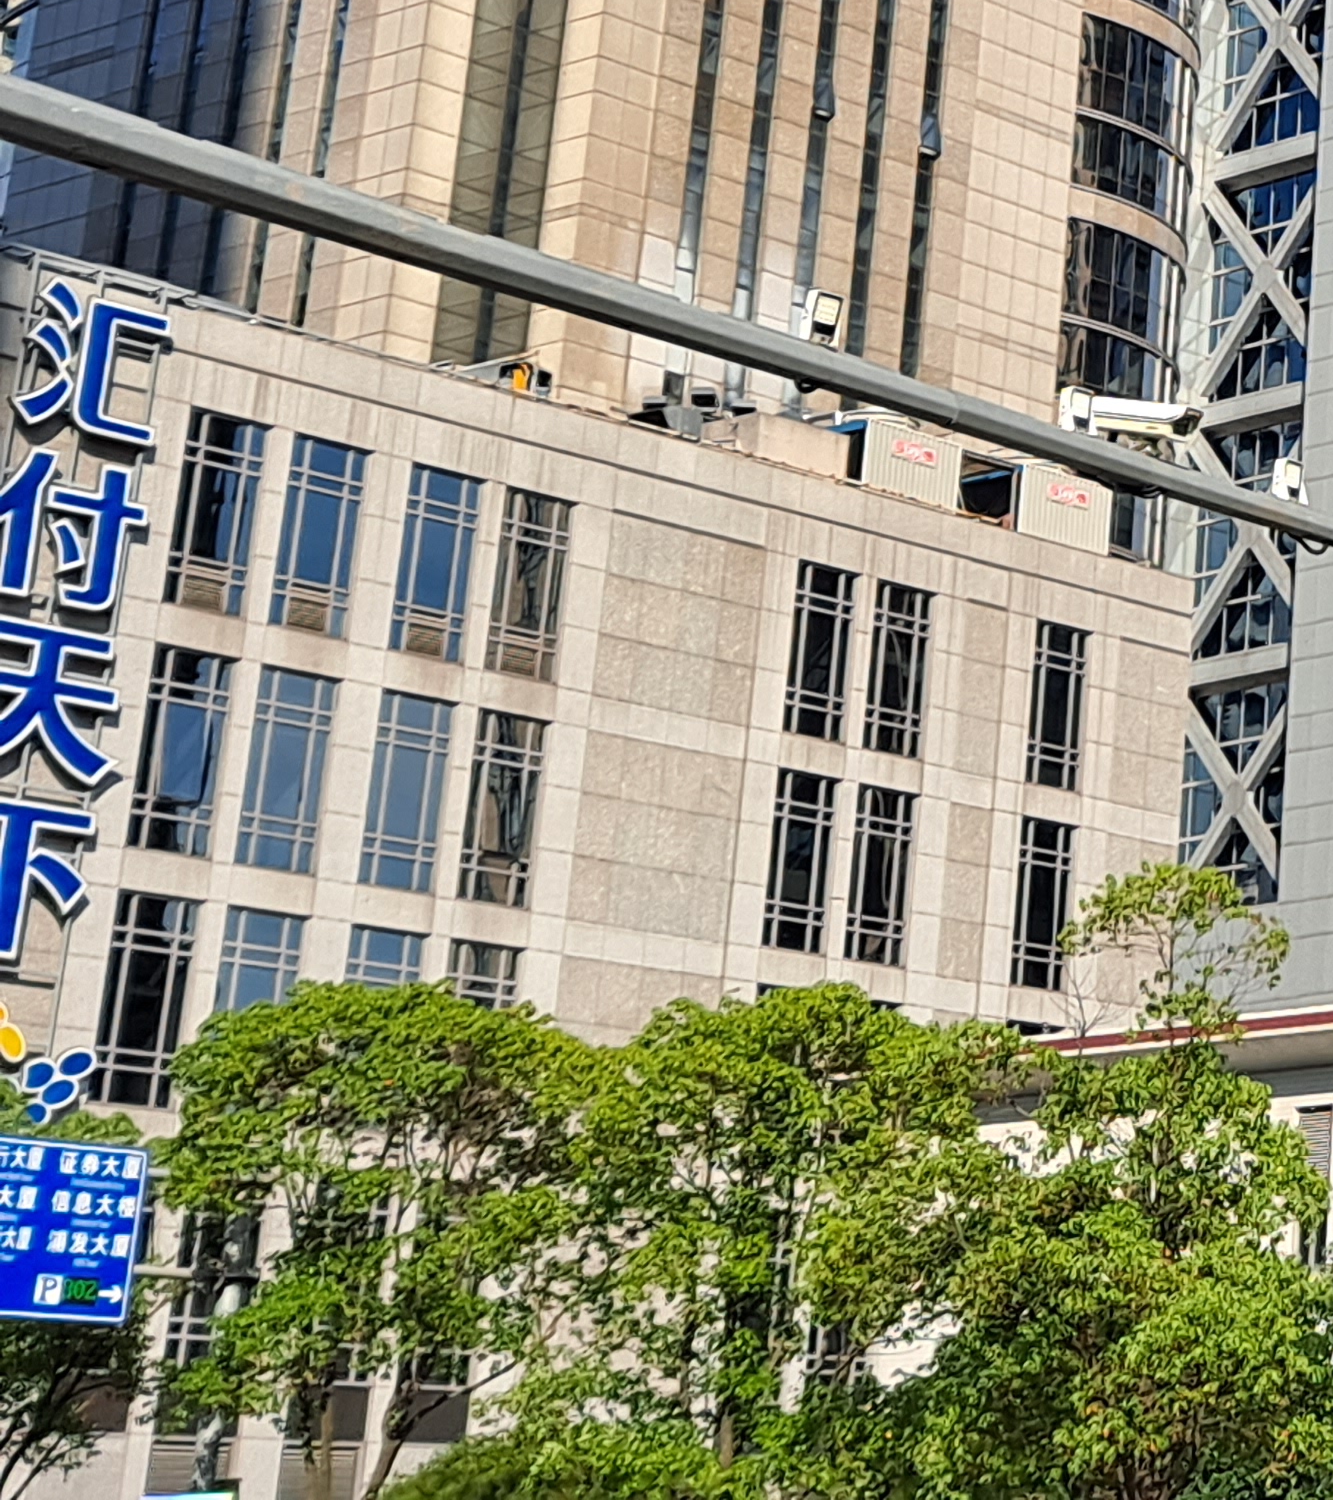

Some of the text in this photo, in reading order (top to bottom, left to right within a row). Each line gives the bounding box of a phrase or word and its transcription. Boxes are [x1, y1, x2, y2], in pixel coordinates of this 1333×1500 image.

[60, 1150, 142, 1179] 证券大厦
[38, 1276, 58, 1302] P
